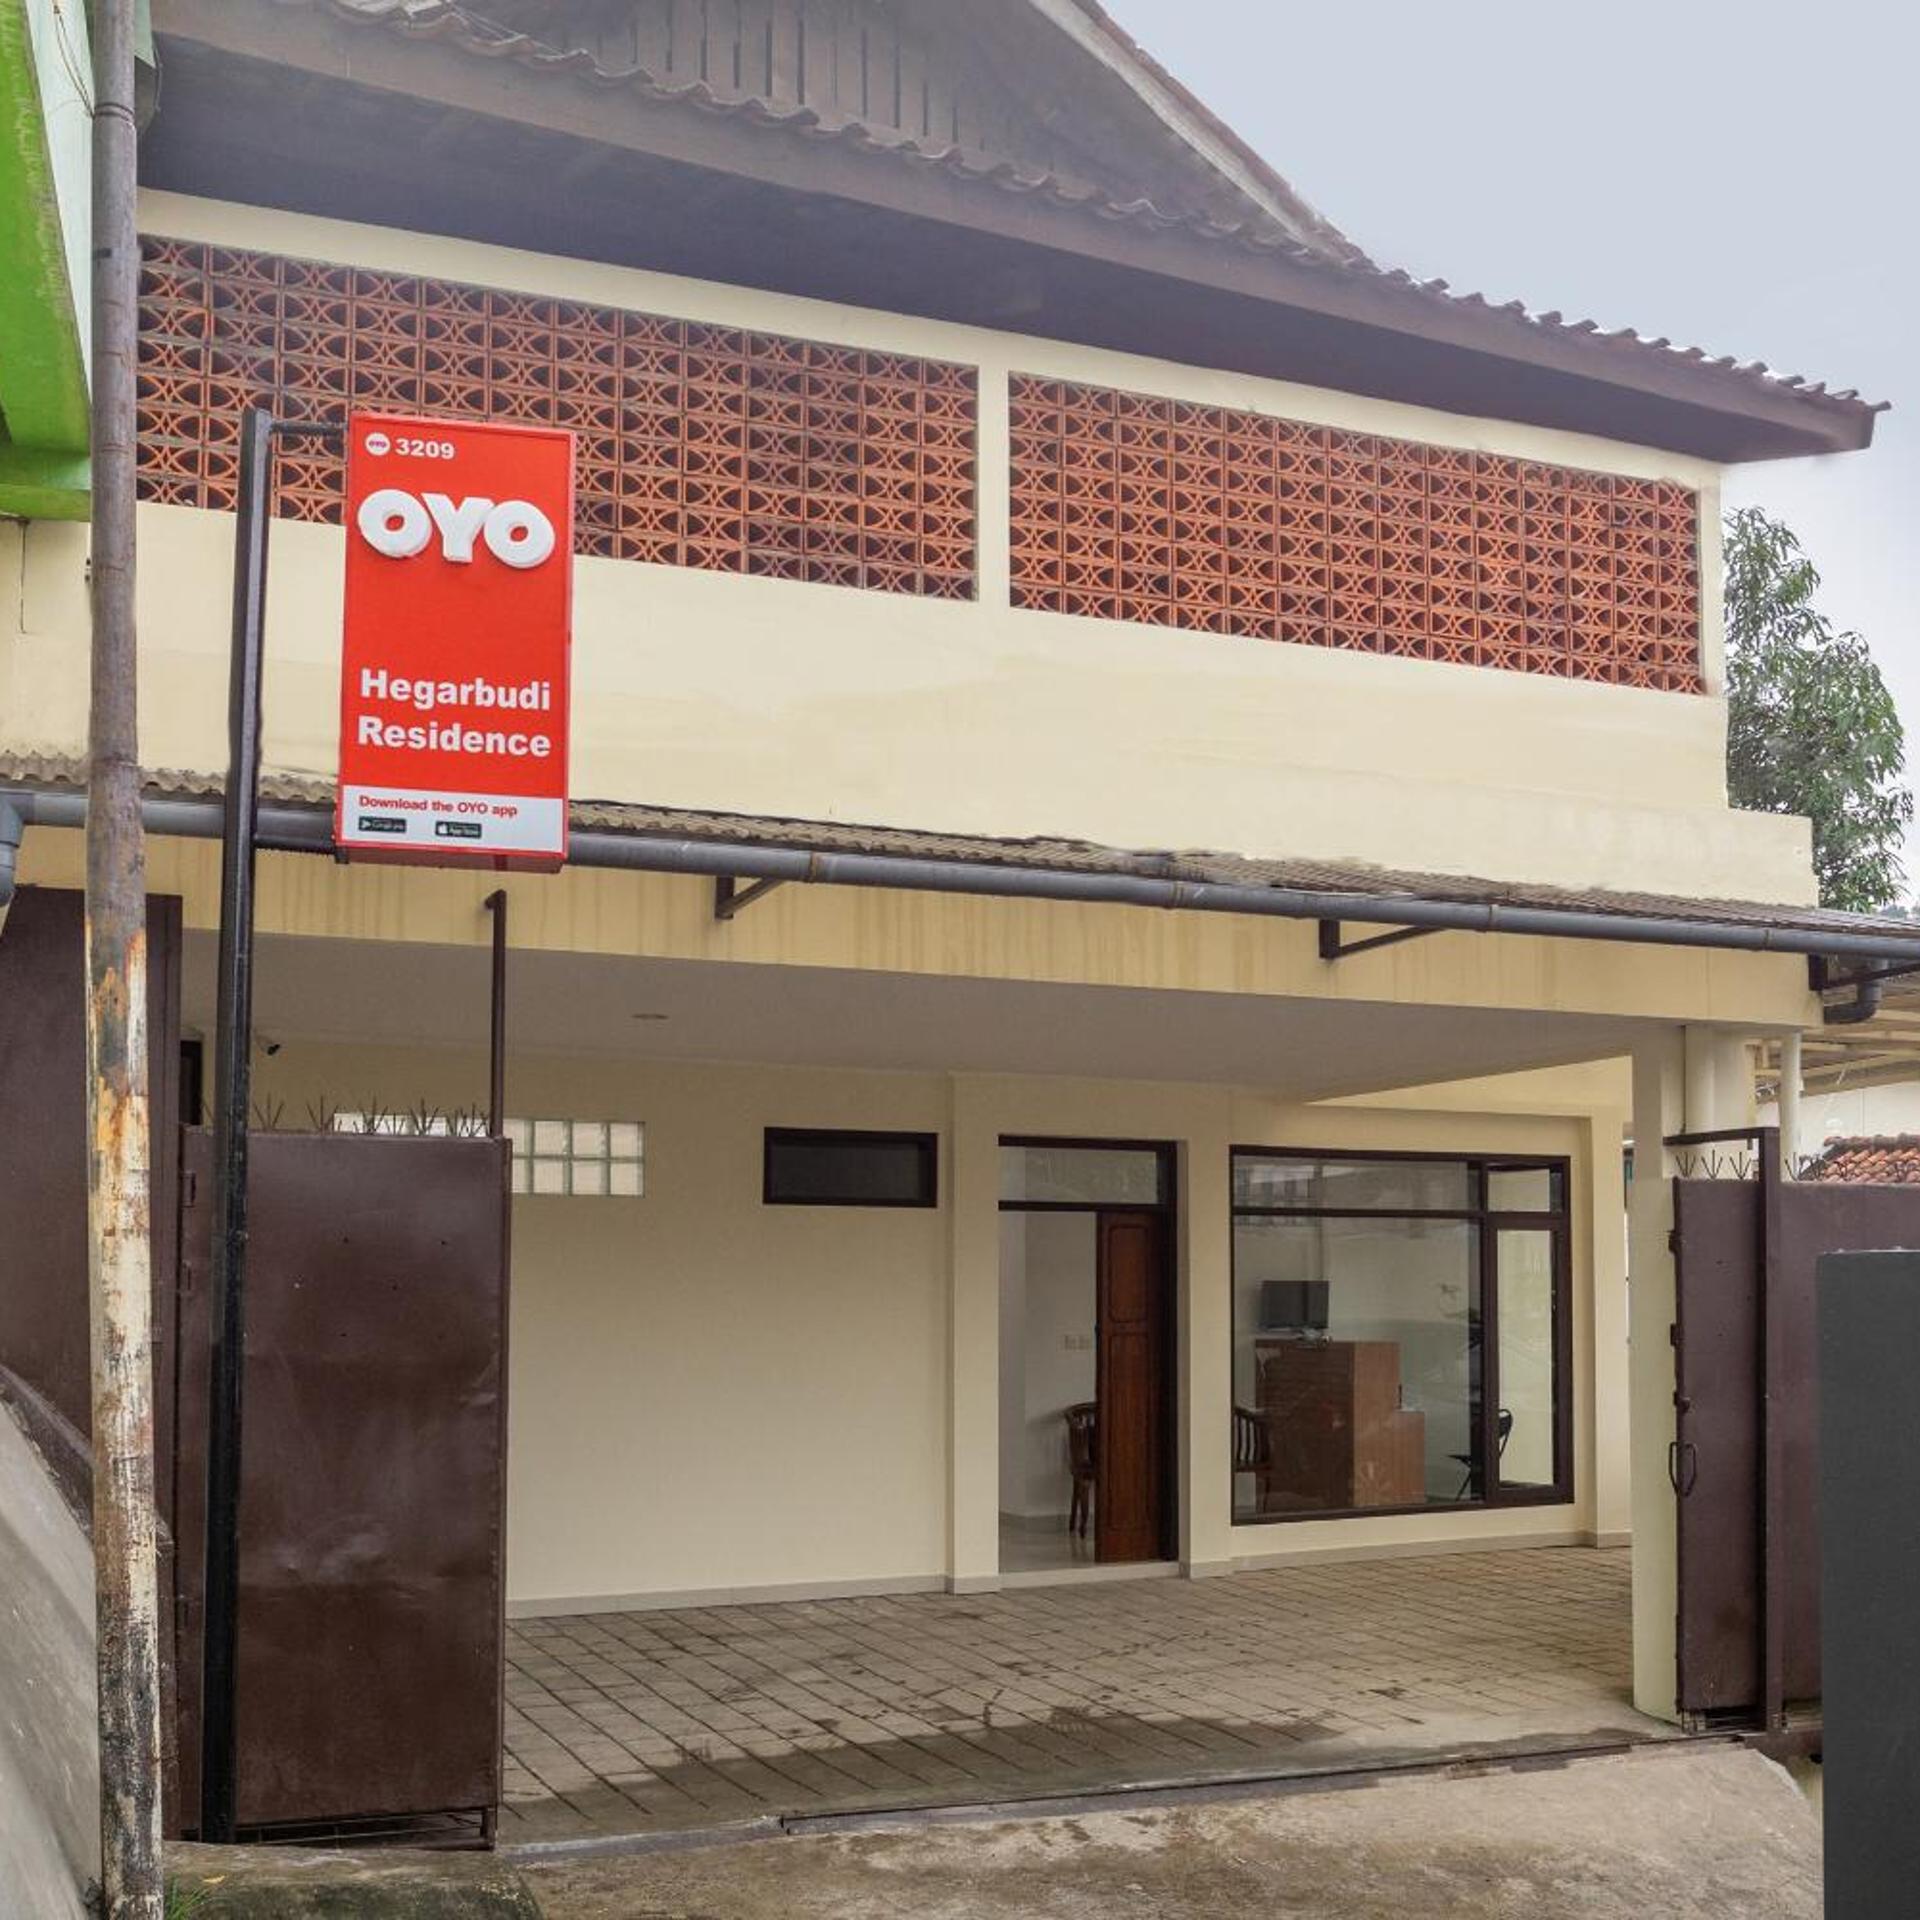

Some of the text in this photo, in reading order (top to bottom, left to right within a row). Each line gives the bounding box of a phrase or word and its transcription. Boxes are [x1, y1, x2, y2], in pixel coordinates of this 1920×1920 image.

[395, 438, 455, 459] 3209
[357, 488, 556, 569] OYO
[361, 668, 550, 711] Hegarbudi
[358, 715, 551, 757] Residence
[359, 795, 517, 819] Download the OYO app
